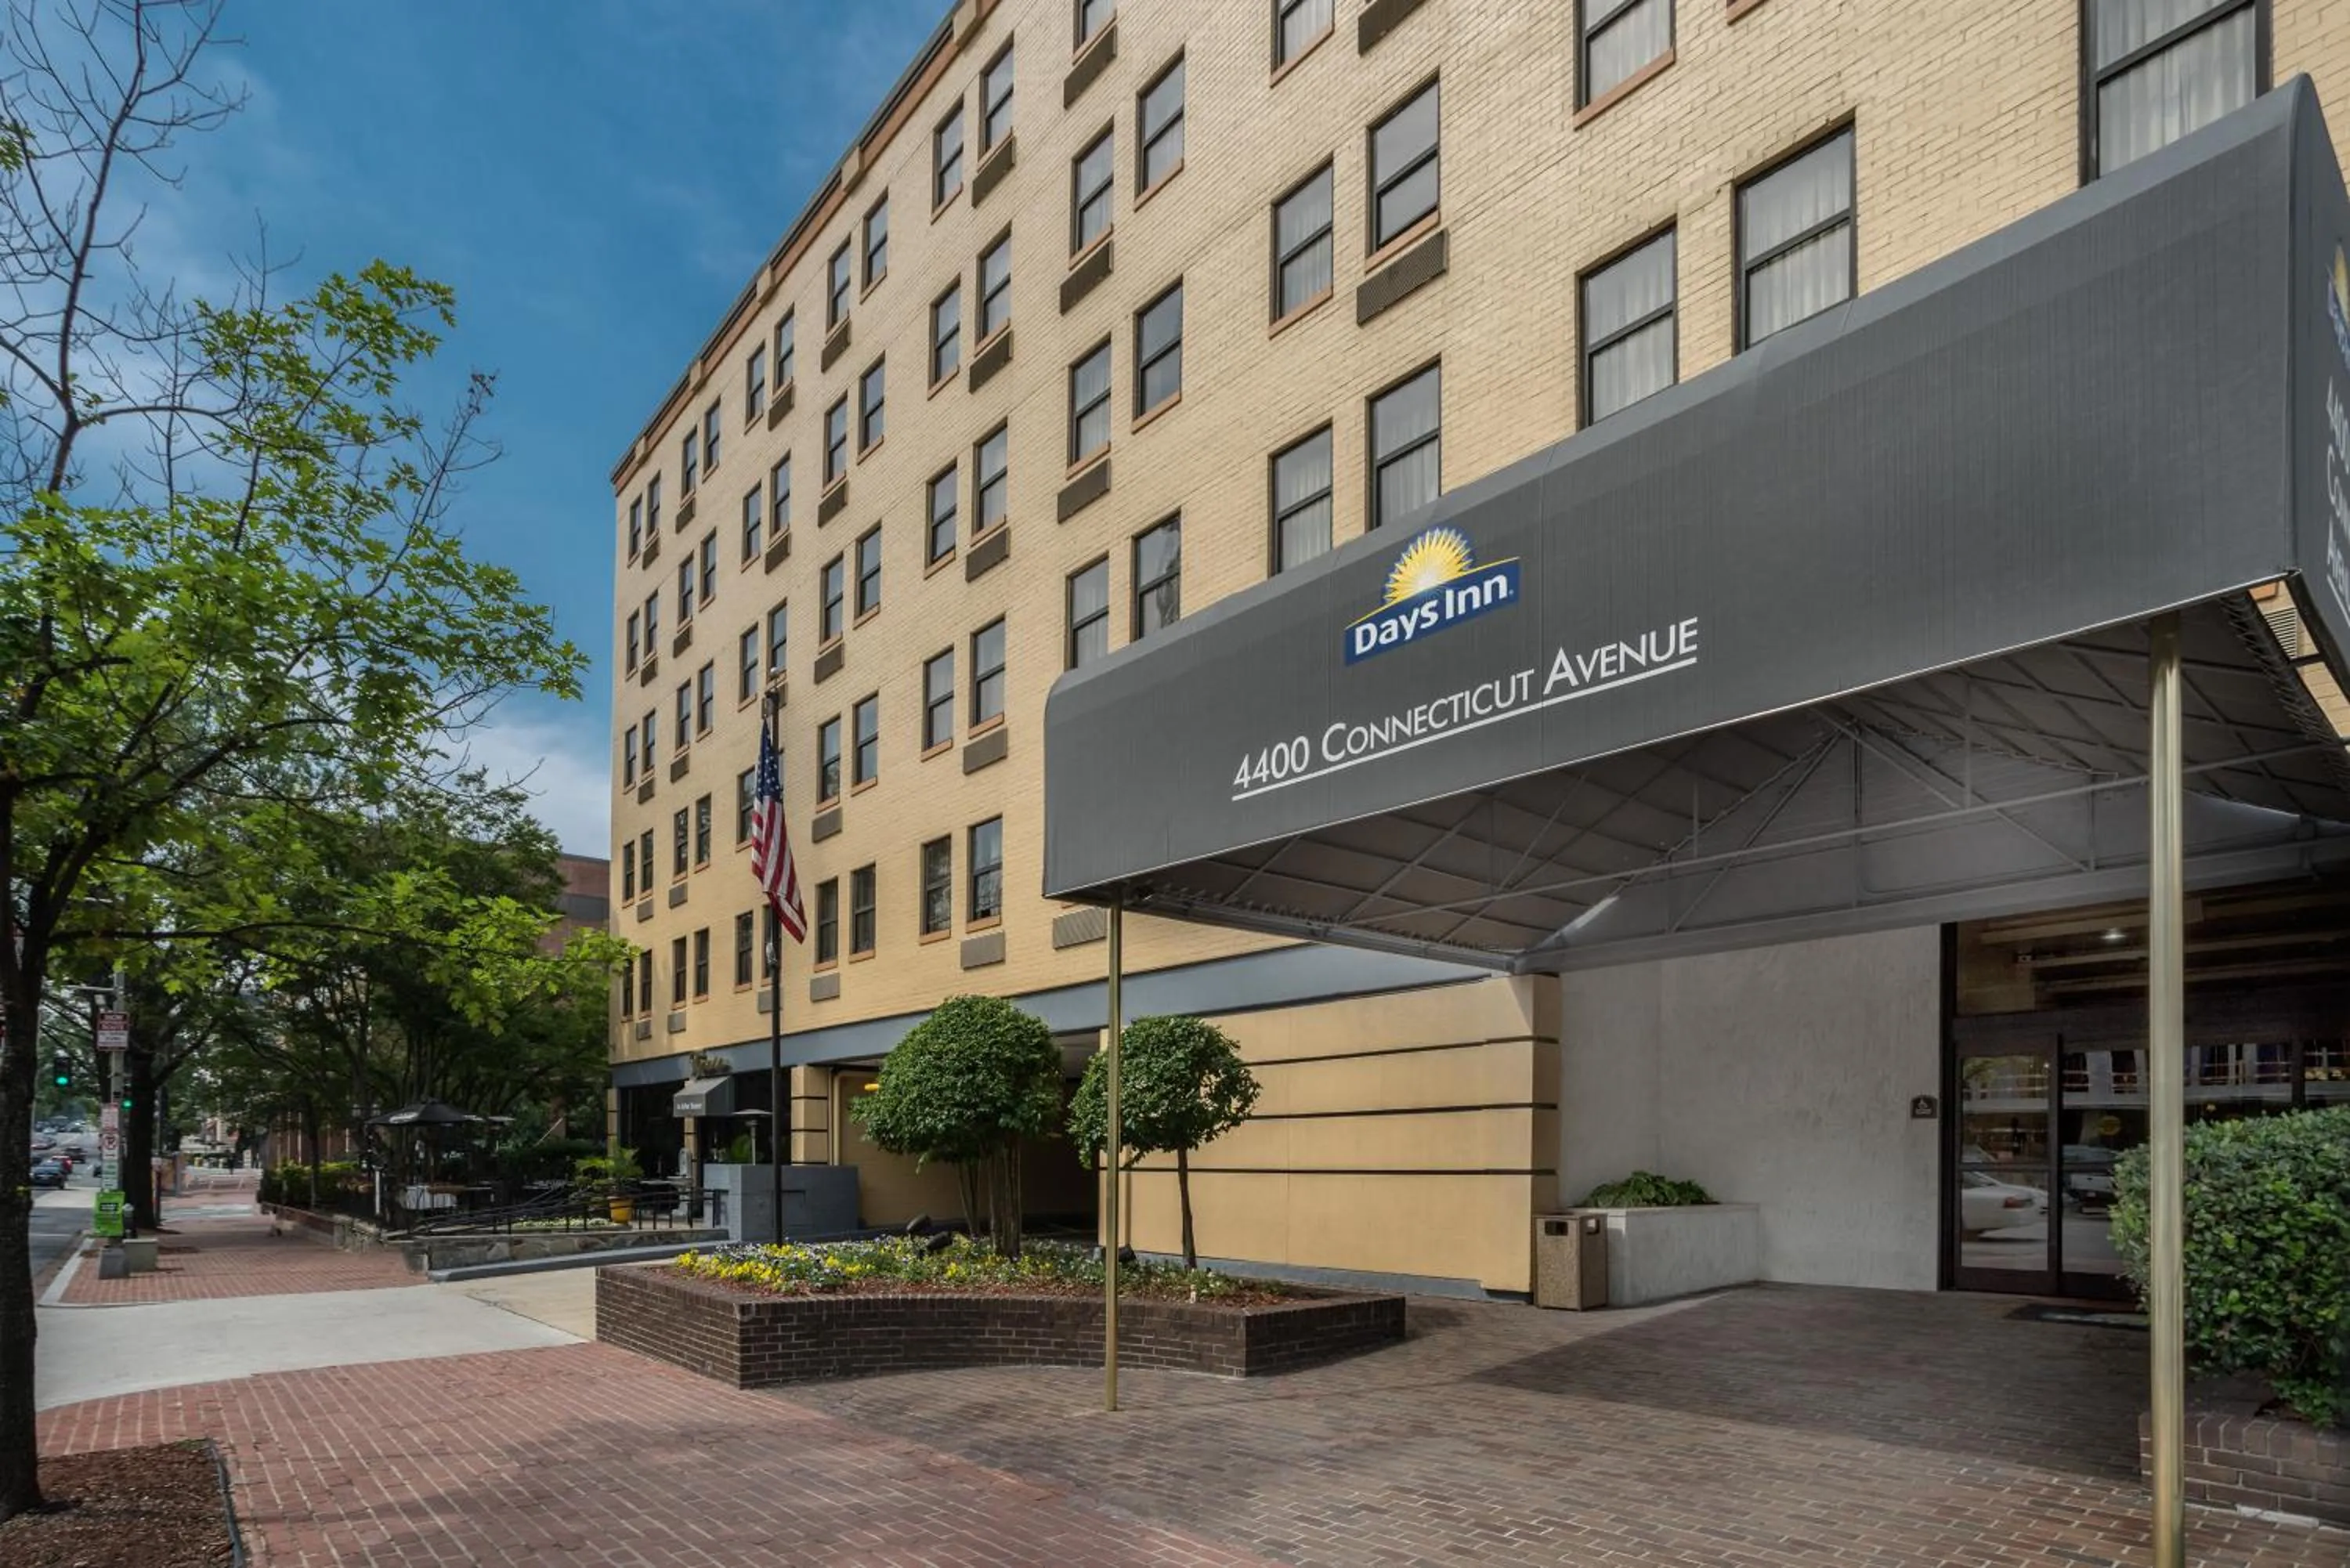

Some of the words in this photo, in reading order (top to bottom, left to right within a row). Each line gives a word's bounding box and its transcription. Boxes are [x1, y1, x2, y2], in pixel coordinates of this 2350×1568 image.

[1354, 598, 1439, 656] Days
[1445, 574, 1508, 620] Inn
[1233, 735, 1311, 789] 4400
[1321, 668, 1535, 762] CONNECTICUT
[1542, 616, 1699, 695] AVENUE
